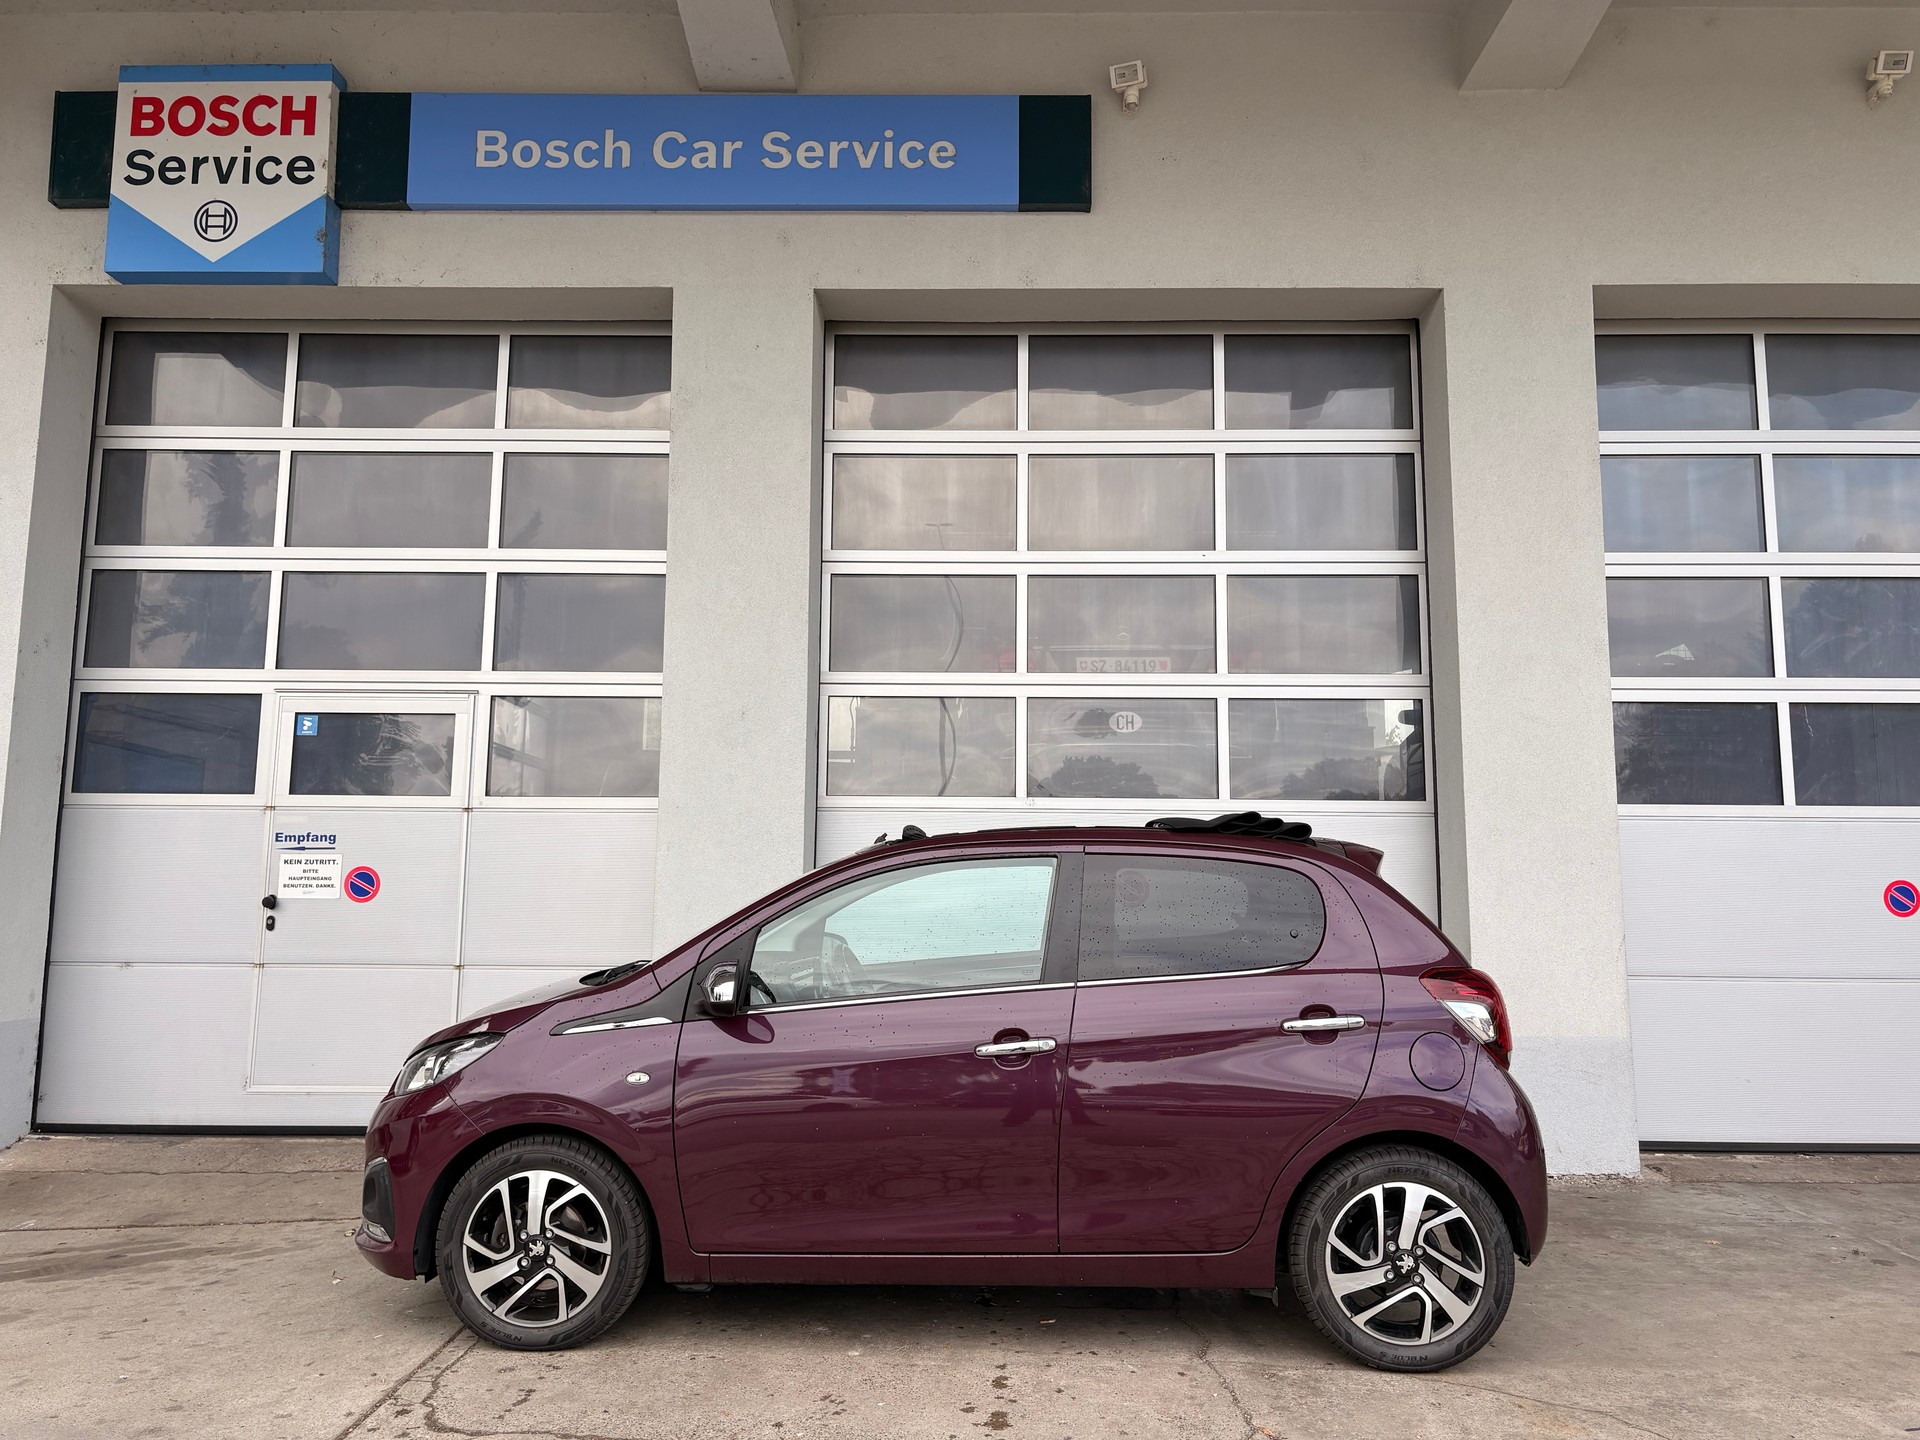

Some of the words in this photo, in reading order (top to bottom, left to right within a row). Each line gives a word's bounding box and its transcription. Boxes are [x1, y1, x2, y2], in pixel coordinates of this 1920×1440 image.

[130, 95, 317, 137] BOSCH
[475, 129, 631, 169] Bosch
[652, 130, 743, 169] Car
[760, 129, 957, 169] Service
[123, 145, 315, 186] Service
[1116, 714, 1135, 731] CH
[274, 832, 337, 845] Empfang
[304, 858, 339, 866] ZUTRITT.
[551, 1156, 588, 1177] NEXEN
[1388, 1166, 1430, 1177] NEXEN
